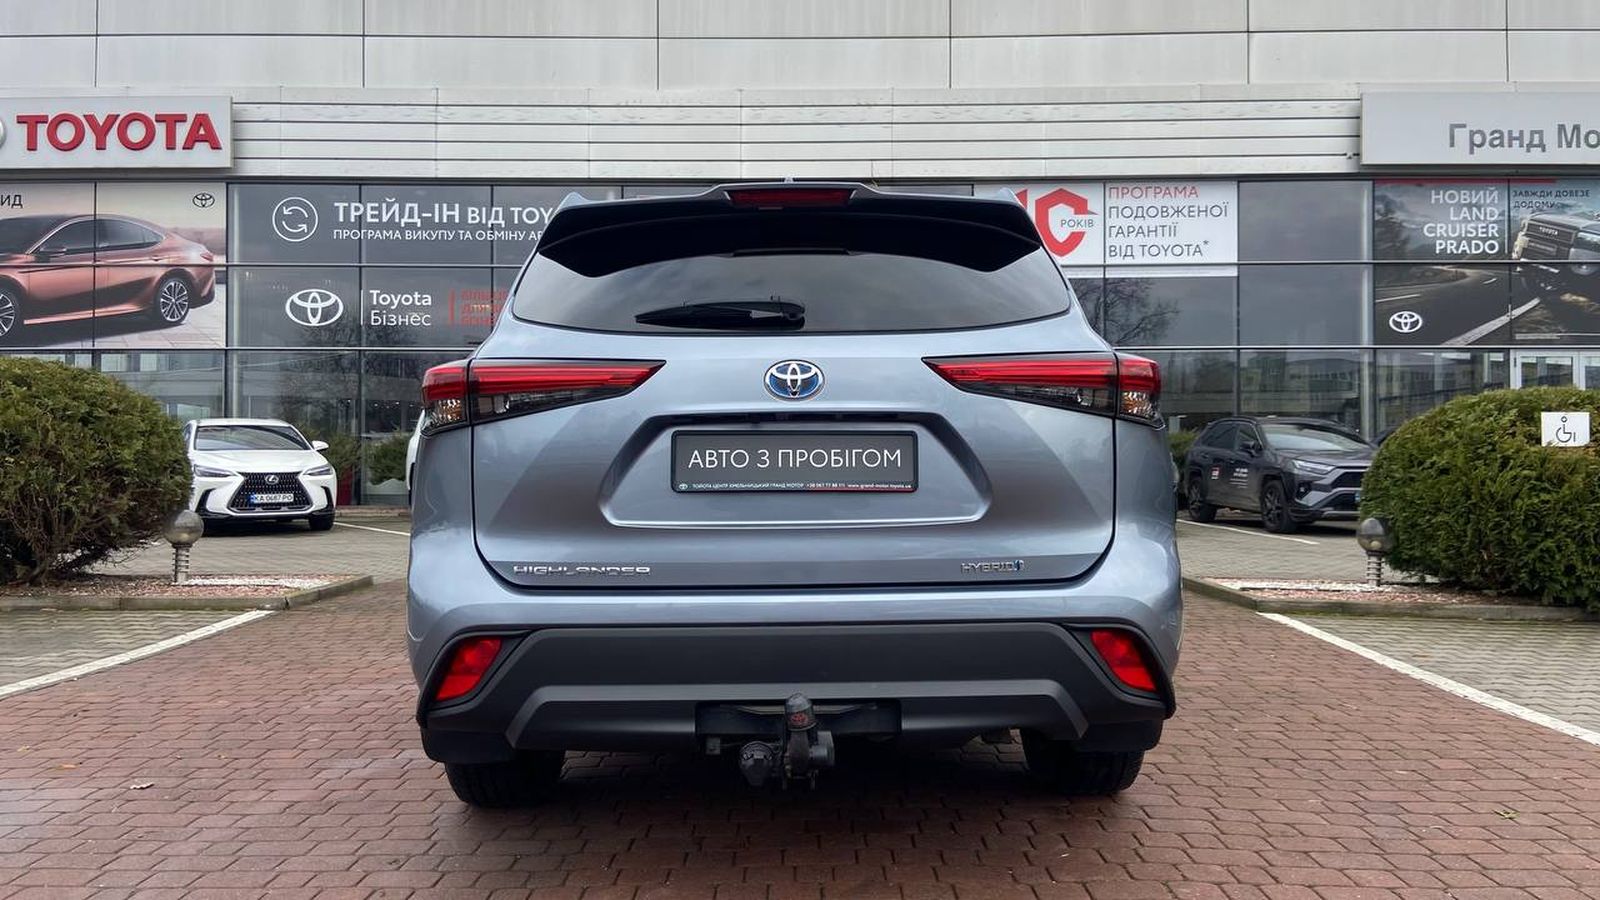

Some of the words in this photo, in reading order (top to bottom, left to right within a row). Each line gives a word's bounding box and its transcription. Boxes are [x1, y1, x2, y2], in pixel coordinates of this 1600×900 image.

[16, 112, 222, 151] TOYOTA
[1449, 124, 1546, 154] Гранд
[1557, 123, 1600, 149] Мо
[1108, 186, 1199, 200] ПРОГРАМА
[1430, 187, 1499, 204] НОВИЙ
[1512, 189, 1553, 198] ЗАВЖДИ
[334, 198, 460, 227] ТРЕЙД-ІН
[467, 206, 505, 228] ВІД
[1108, 202, 1228, 220] ПОДОВЖЕНОЇ
[1450, 207, 1499, 221] LAND
[1060, 219, 1095, 229] РОКІВ
[1108, 222, 1178, 238] ГАРАНТІЇ
[1423, 223, 1499, 237] CRUISER
[333, 228, 402, 241] ПРОГРАМА
[406, 229, 455, 241] ВИКУПУ
[458, 230, 473, 241] ТА
[475, 230, 527, 241] ОБМІНУ
[1108, 245, 1135, 260] ВІД
[1435, 240, 1499, 254] PRADO
[370, 290, 432, 309] Toyota
[370, 310, 431, 326] Бізнес
[688, 450, 749, 468] АВТО
[757, 450, 770, 468] З
[778, 449, 901, 468] ПРОБІГОМ
[513, 565, 651, 576] HIGHLANDER
[961, 562, 1014, 572] HYBRID
